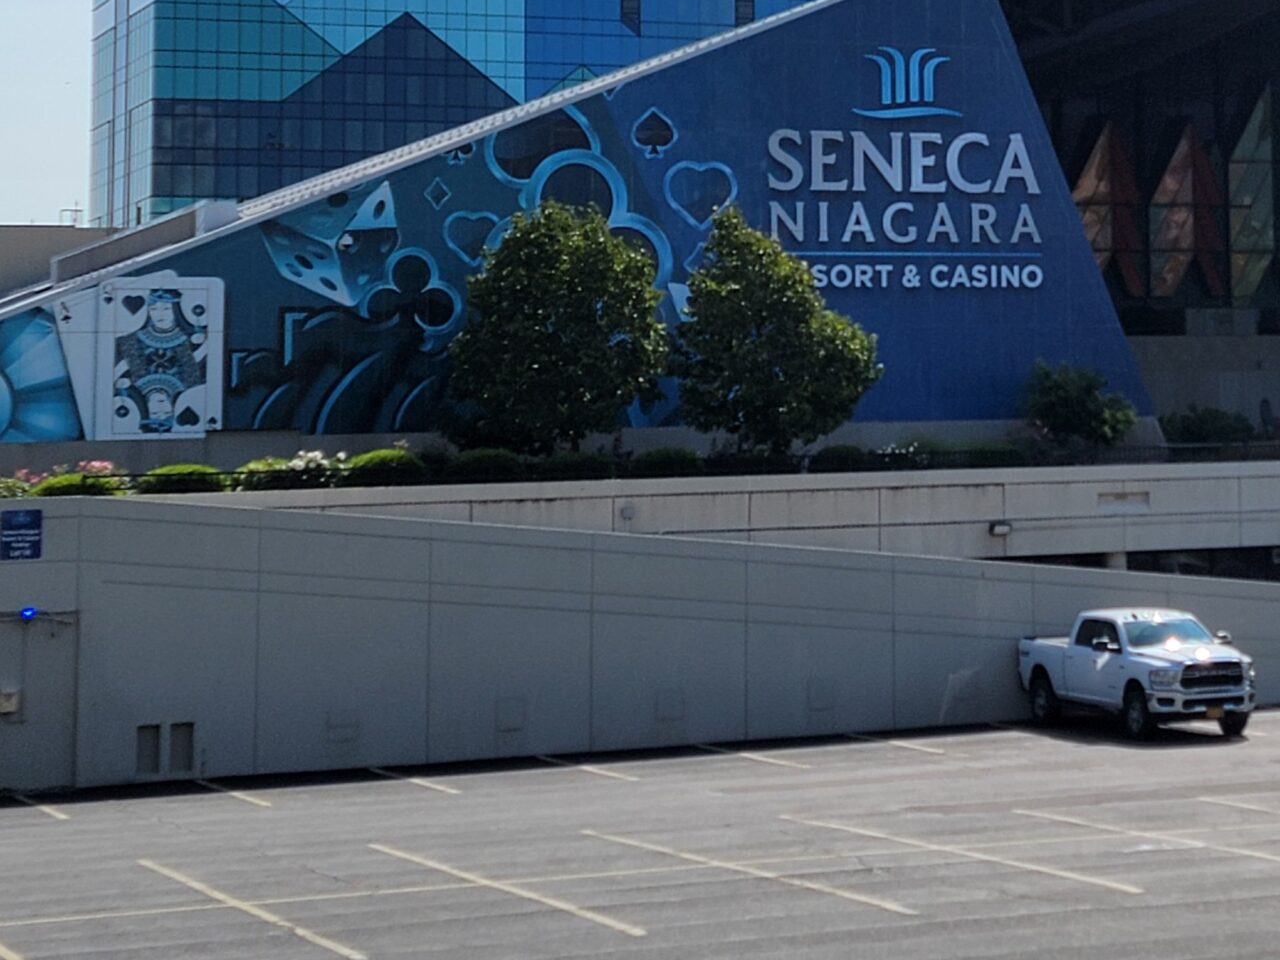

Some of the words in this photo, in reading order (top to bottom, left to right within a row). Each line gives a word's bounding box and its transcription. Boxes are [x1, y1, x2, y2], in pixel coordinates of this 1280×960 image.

[767, 128, 1041, 194] SENECA
[768, 200, 1042, 244] NIAGARA
[812, 263, 894, 288] SORT
[901, 263, 921, 288] &
[930, 263, 1044, 288] CASINO
